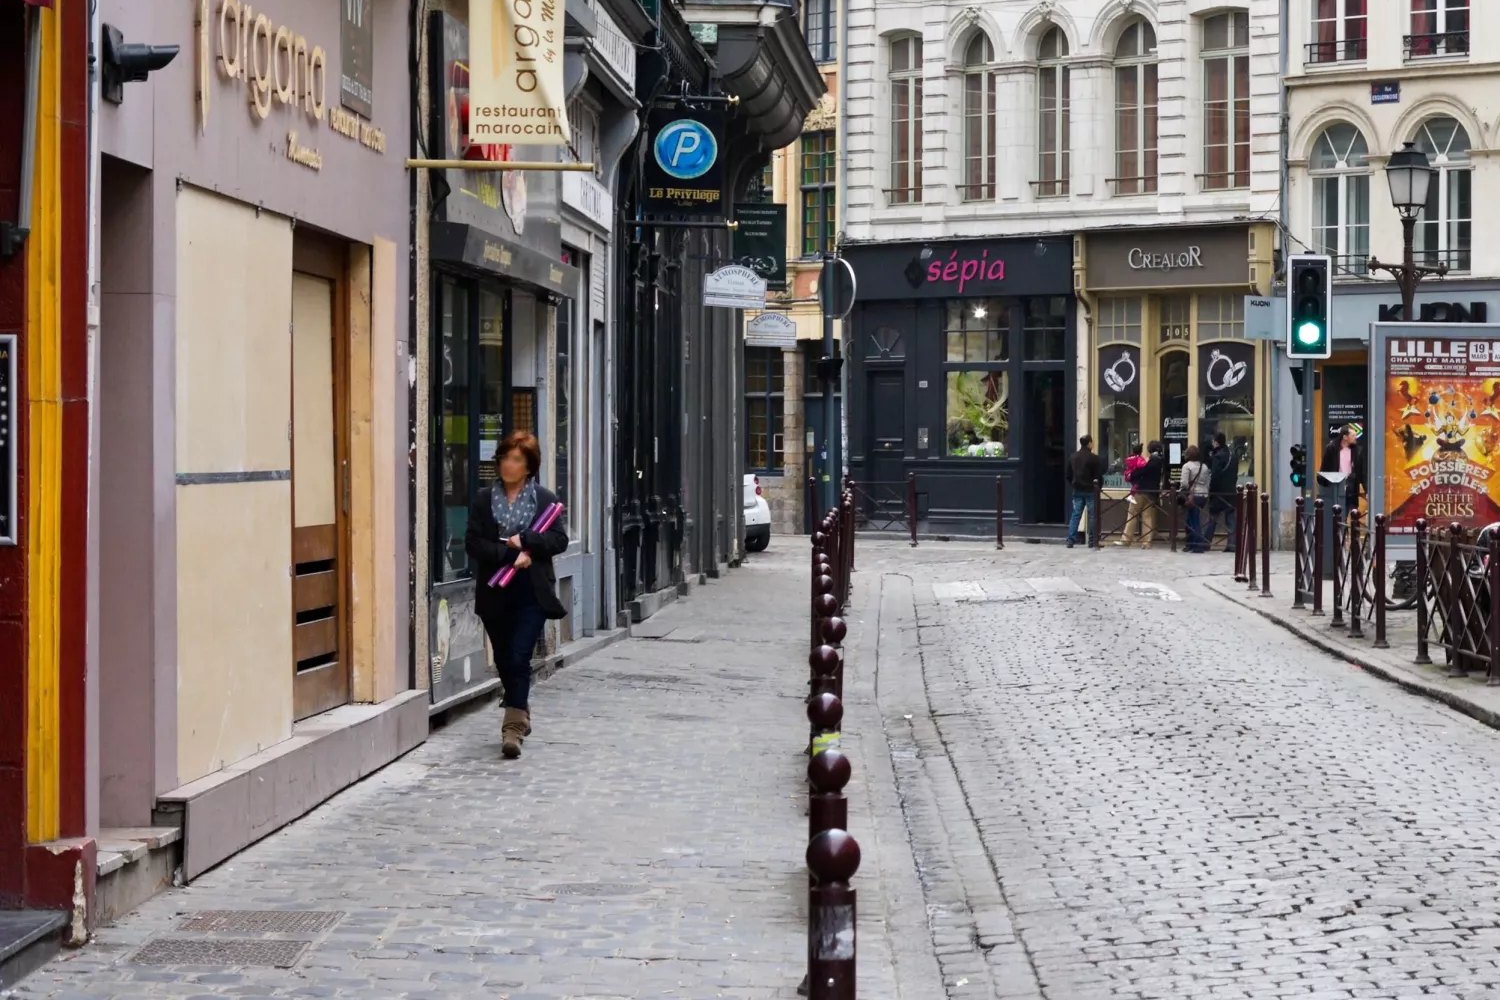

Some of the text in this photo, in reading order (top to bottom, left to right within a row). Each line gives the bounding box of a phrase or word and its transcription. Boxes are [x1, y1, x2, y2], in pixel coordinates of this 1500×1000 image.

[475, 104, 563, 118] restaurant
[475, 122, 563, 136] marocain
[926, 249, 1006, 294] sépia
[1250, 300, 1271, 308] KUONI
[1390, 340, 1467, 358] LILLE
[1473, 343, 1485, 354] 19
[1426, 493, 1474, 503] ARLETTE
[1425, 502, 1475, 517] GRUSS
